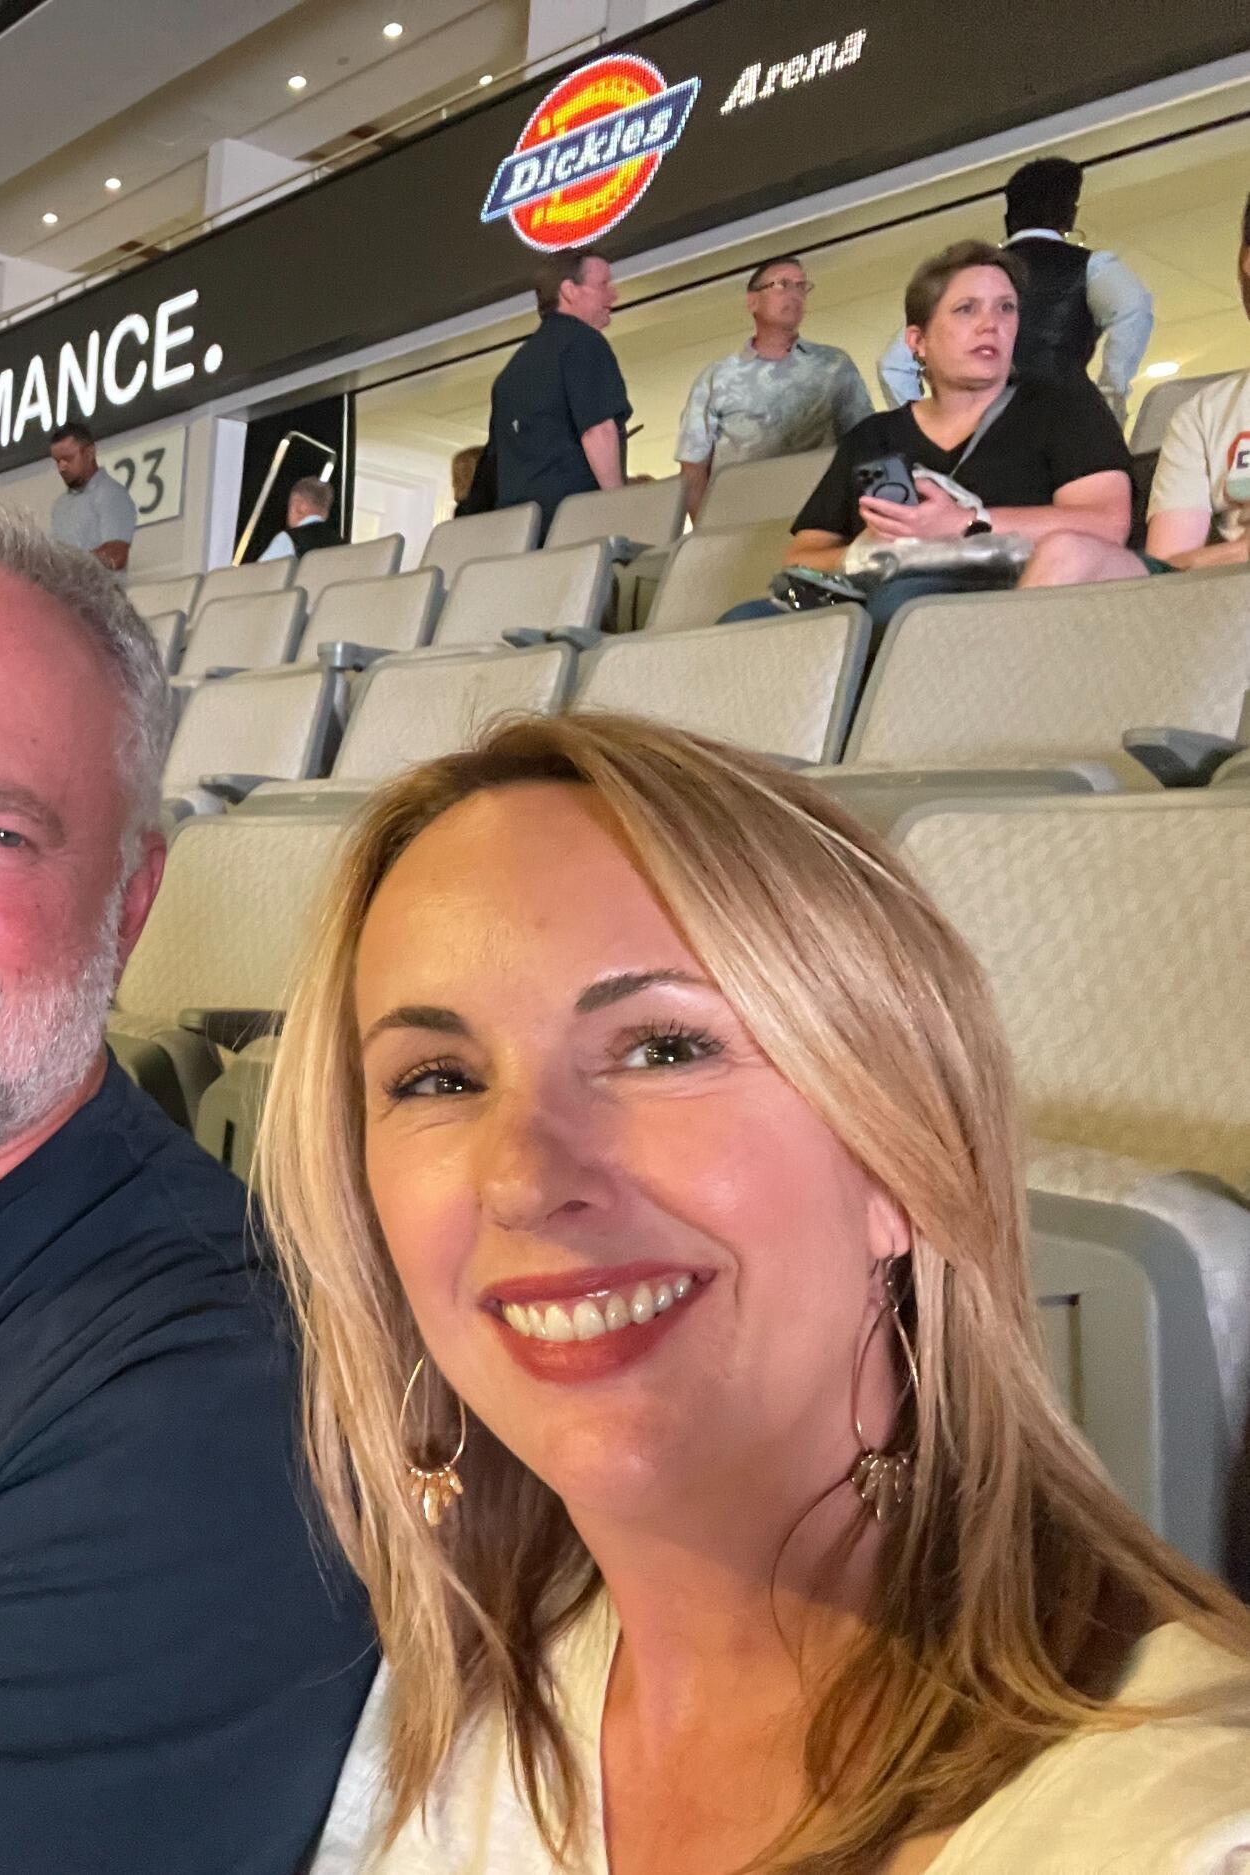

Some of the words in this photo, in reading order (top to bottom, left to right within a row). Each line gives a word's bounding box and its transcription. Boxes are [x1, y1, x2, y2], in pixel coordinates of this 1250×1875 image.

[502, 105, 674, 201] Dickies
[720, 28, 868, 116] Arena
[113, 447, 166, 515] 23
